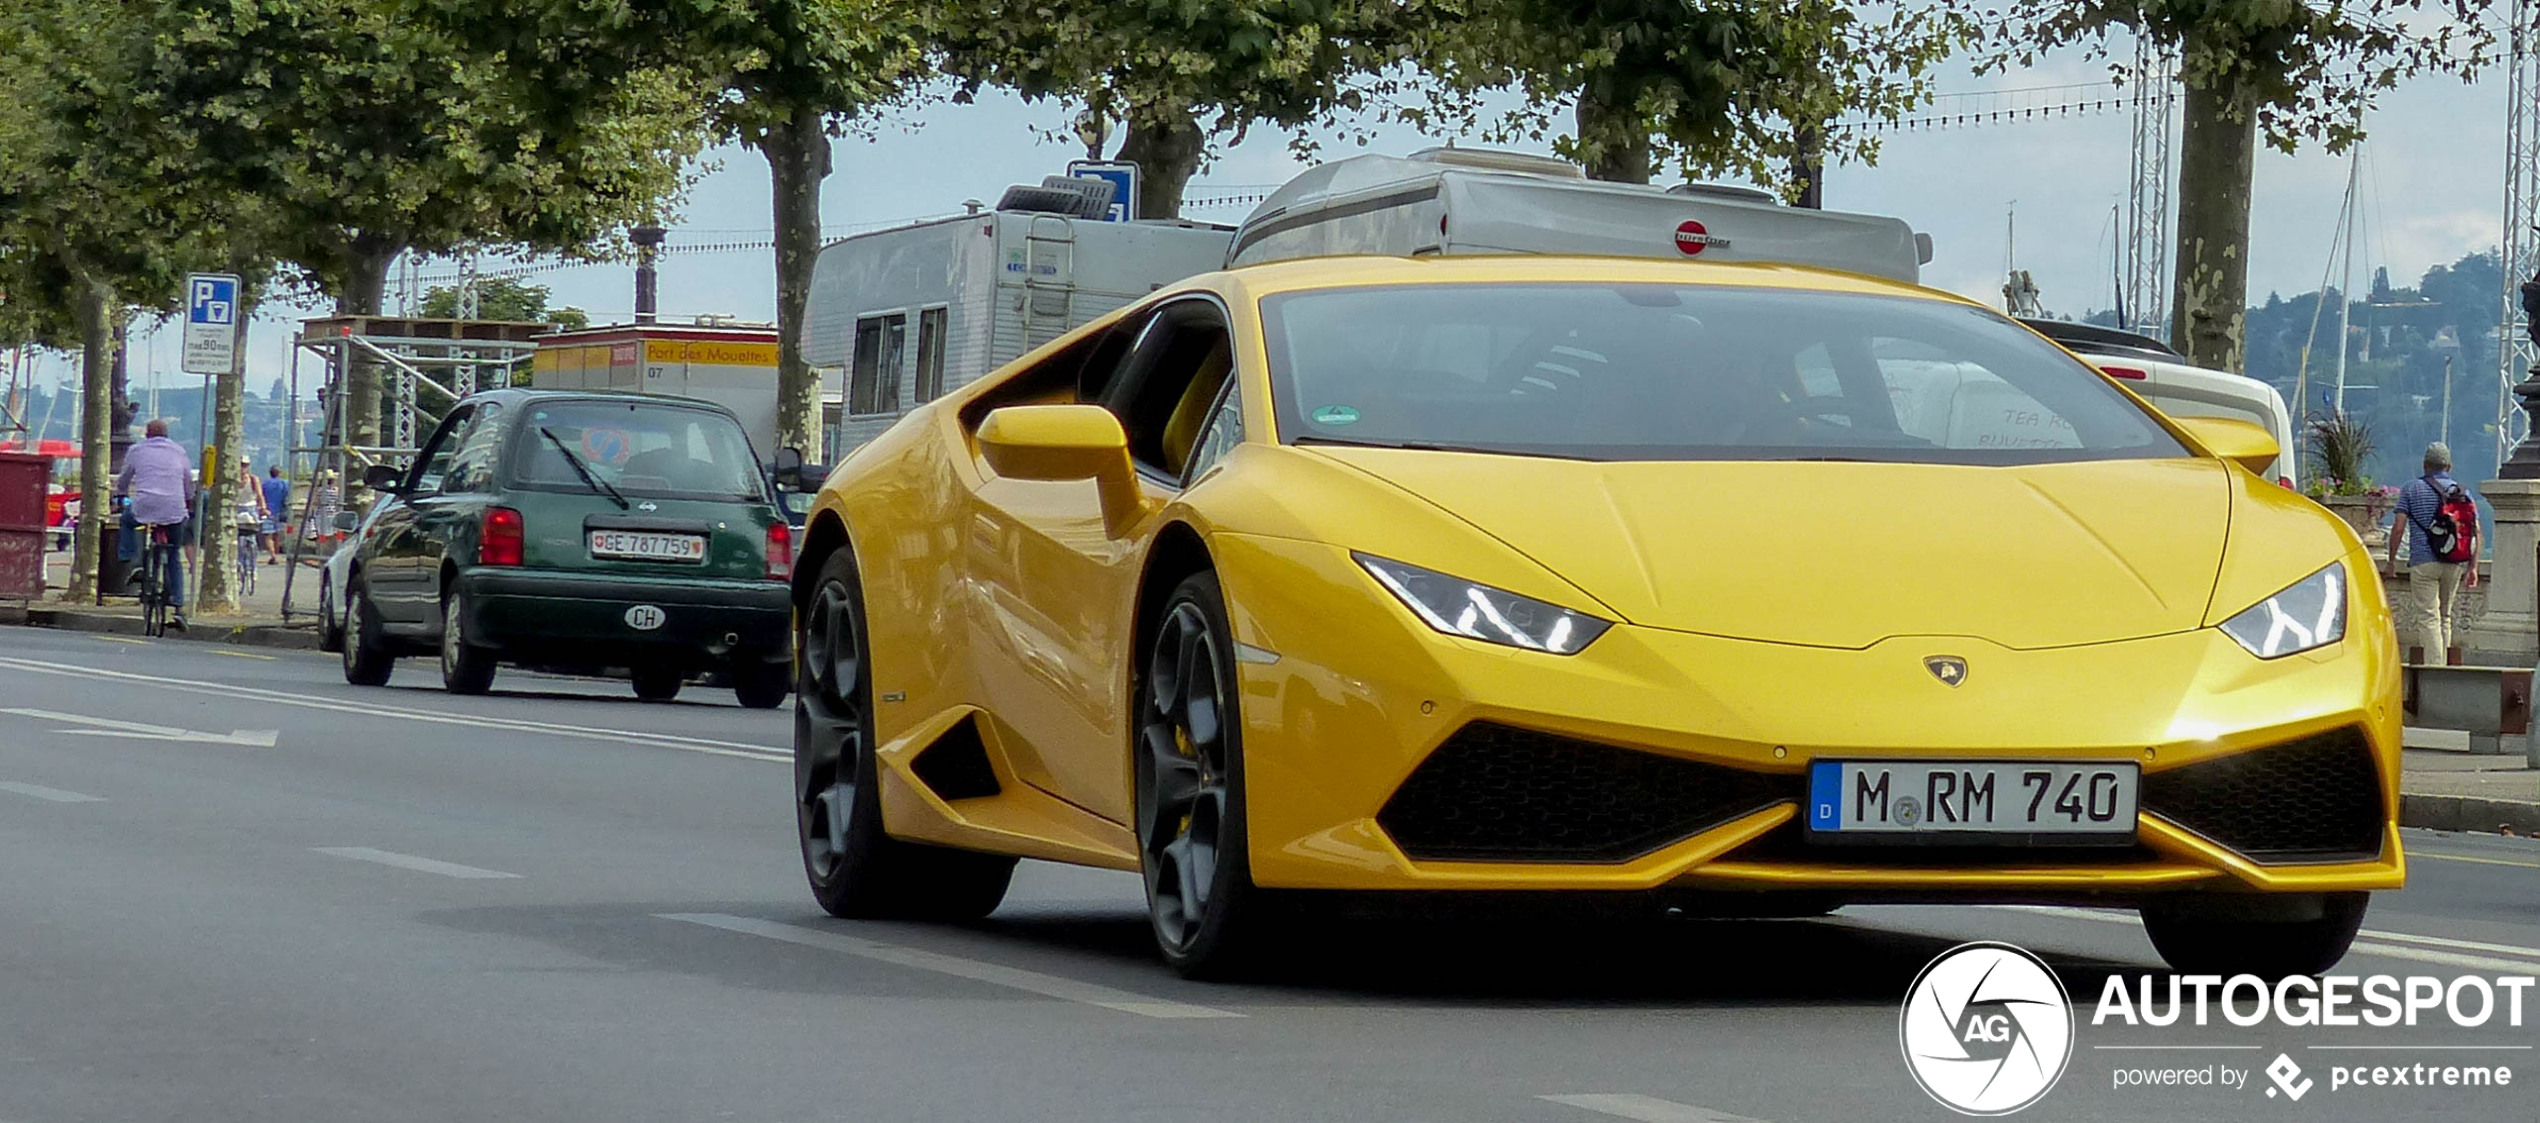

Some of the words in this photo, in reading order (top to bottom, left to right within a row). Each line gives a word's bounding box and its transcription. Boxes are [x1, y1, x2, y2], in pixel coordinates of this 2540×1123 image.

[195, 282, 214, 308] P
[203, 340, 217, 351] 90
[648, 345, 674, 359] Port
[680, 342, 702, 360] des
[707, 348, 769, 363] Mouettes
[648, 367, 664, 379] 07
[2005, 409, 2039, 427] TEA
[605, 534, 624, 552] GE
[634, 609, 656, 627] CH
[1819, 803, 1832, 819] D
[1855, 771, 1890, 823] M
[1926, 771, 1996, 823] RM
[2022, 771, 2118, 823] 740
